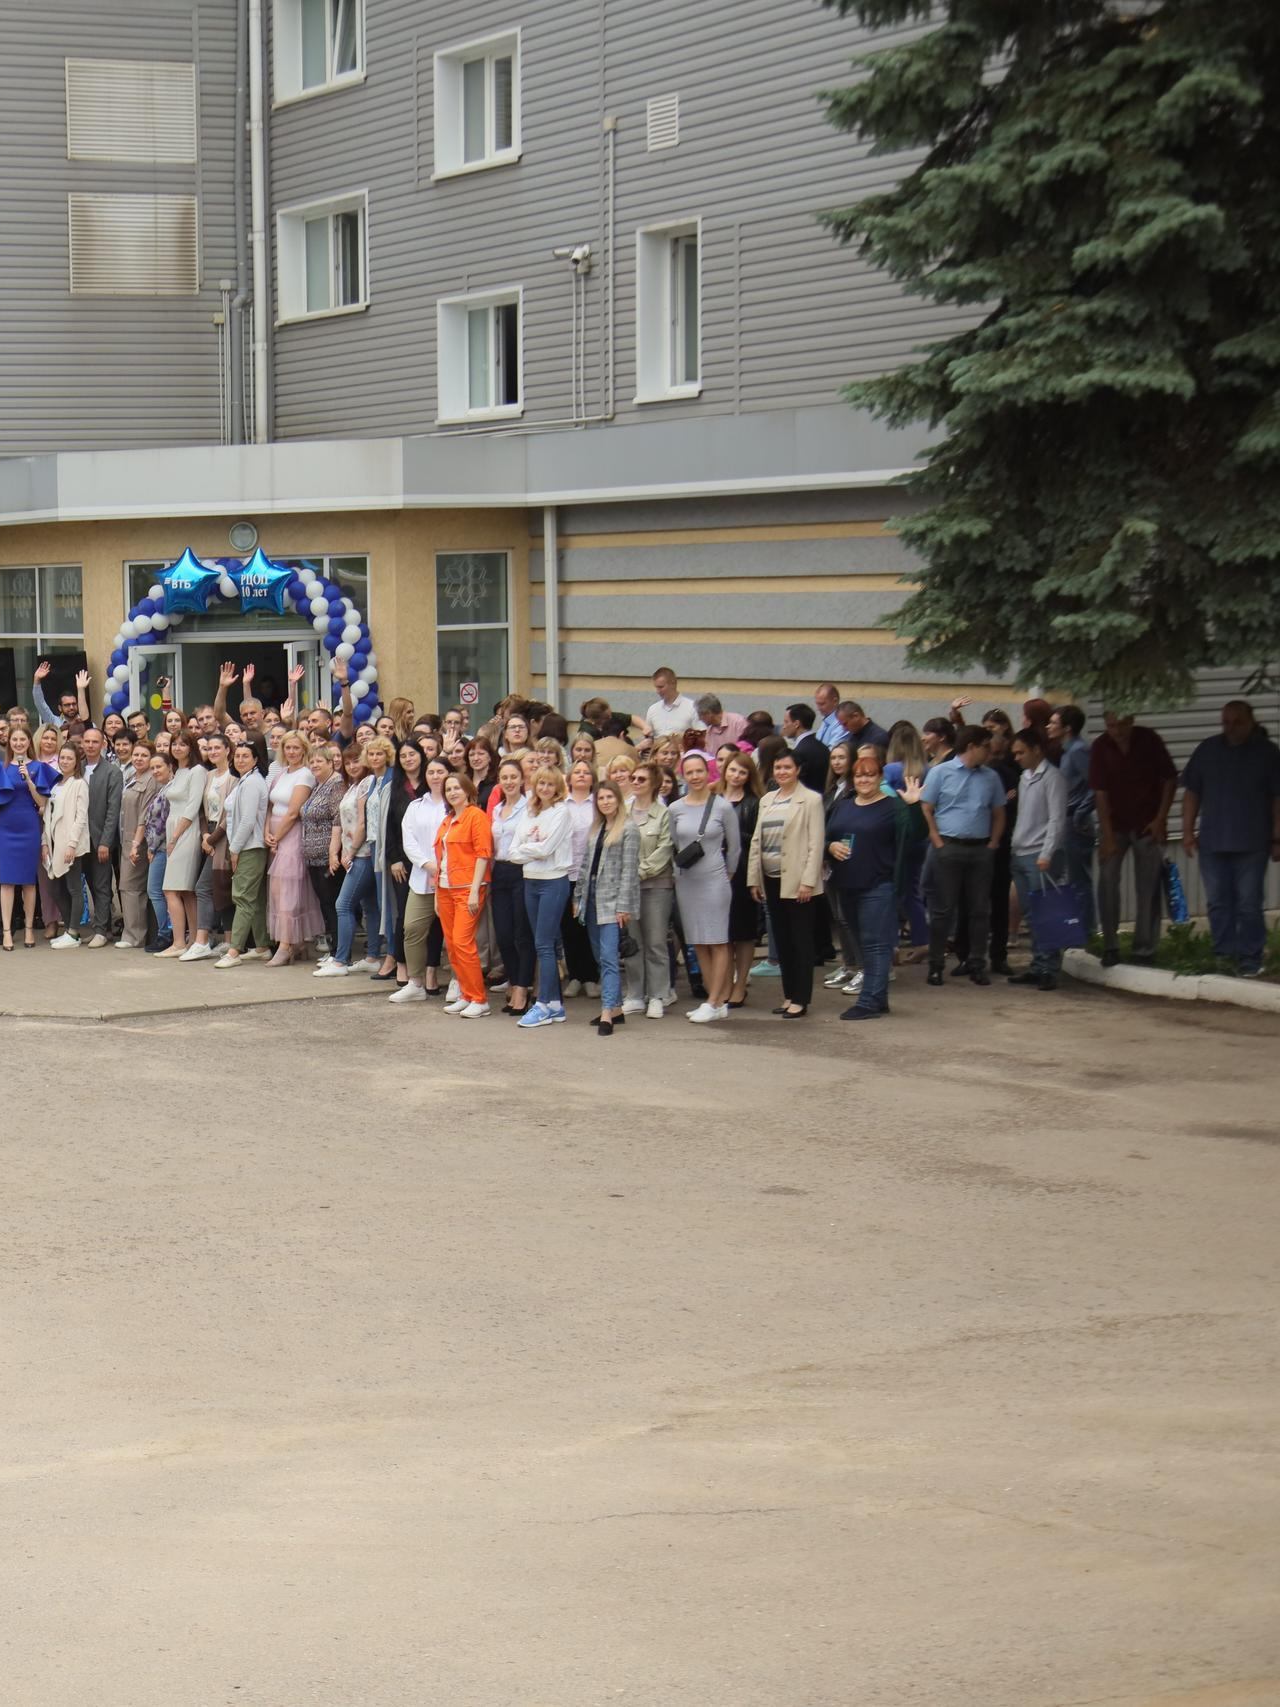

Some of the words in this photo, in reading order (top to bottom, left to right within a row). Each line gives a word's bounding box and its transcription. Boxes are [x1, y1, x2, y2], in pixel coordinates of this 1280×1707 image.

[171, 579, 191, 589] ВТБ
[240, 574, 268, 586] РЦОП
[241, 586, 251, 597] 10
[252, 587, 268, 597] лет
